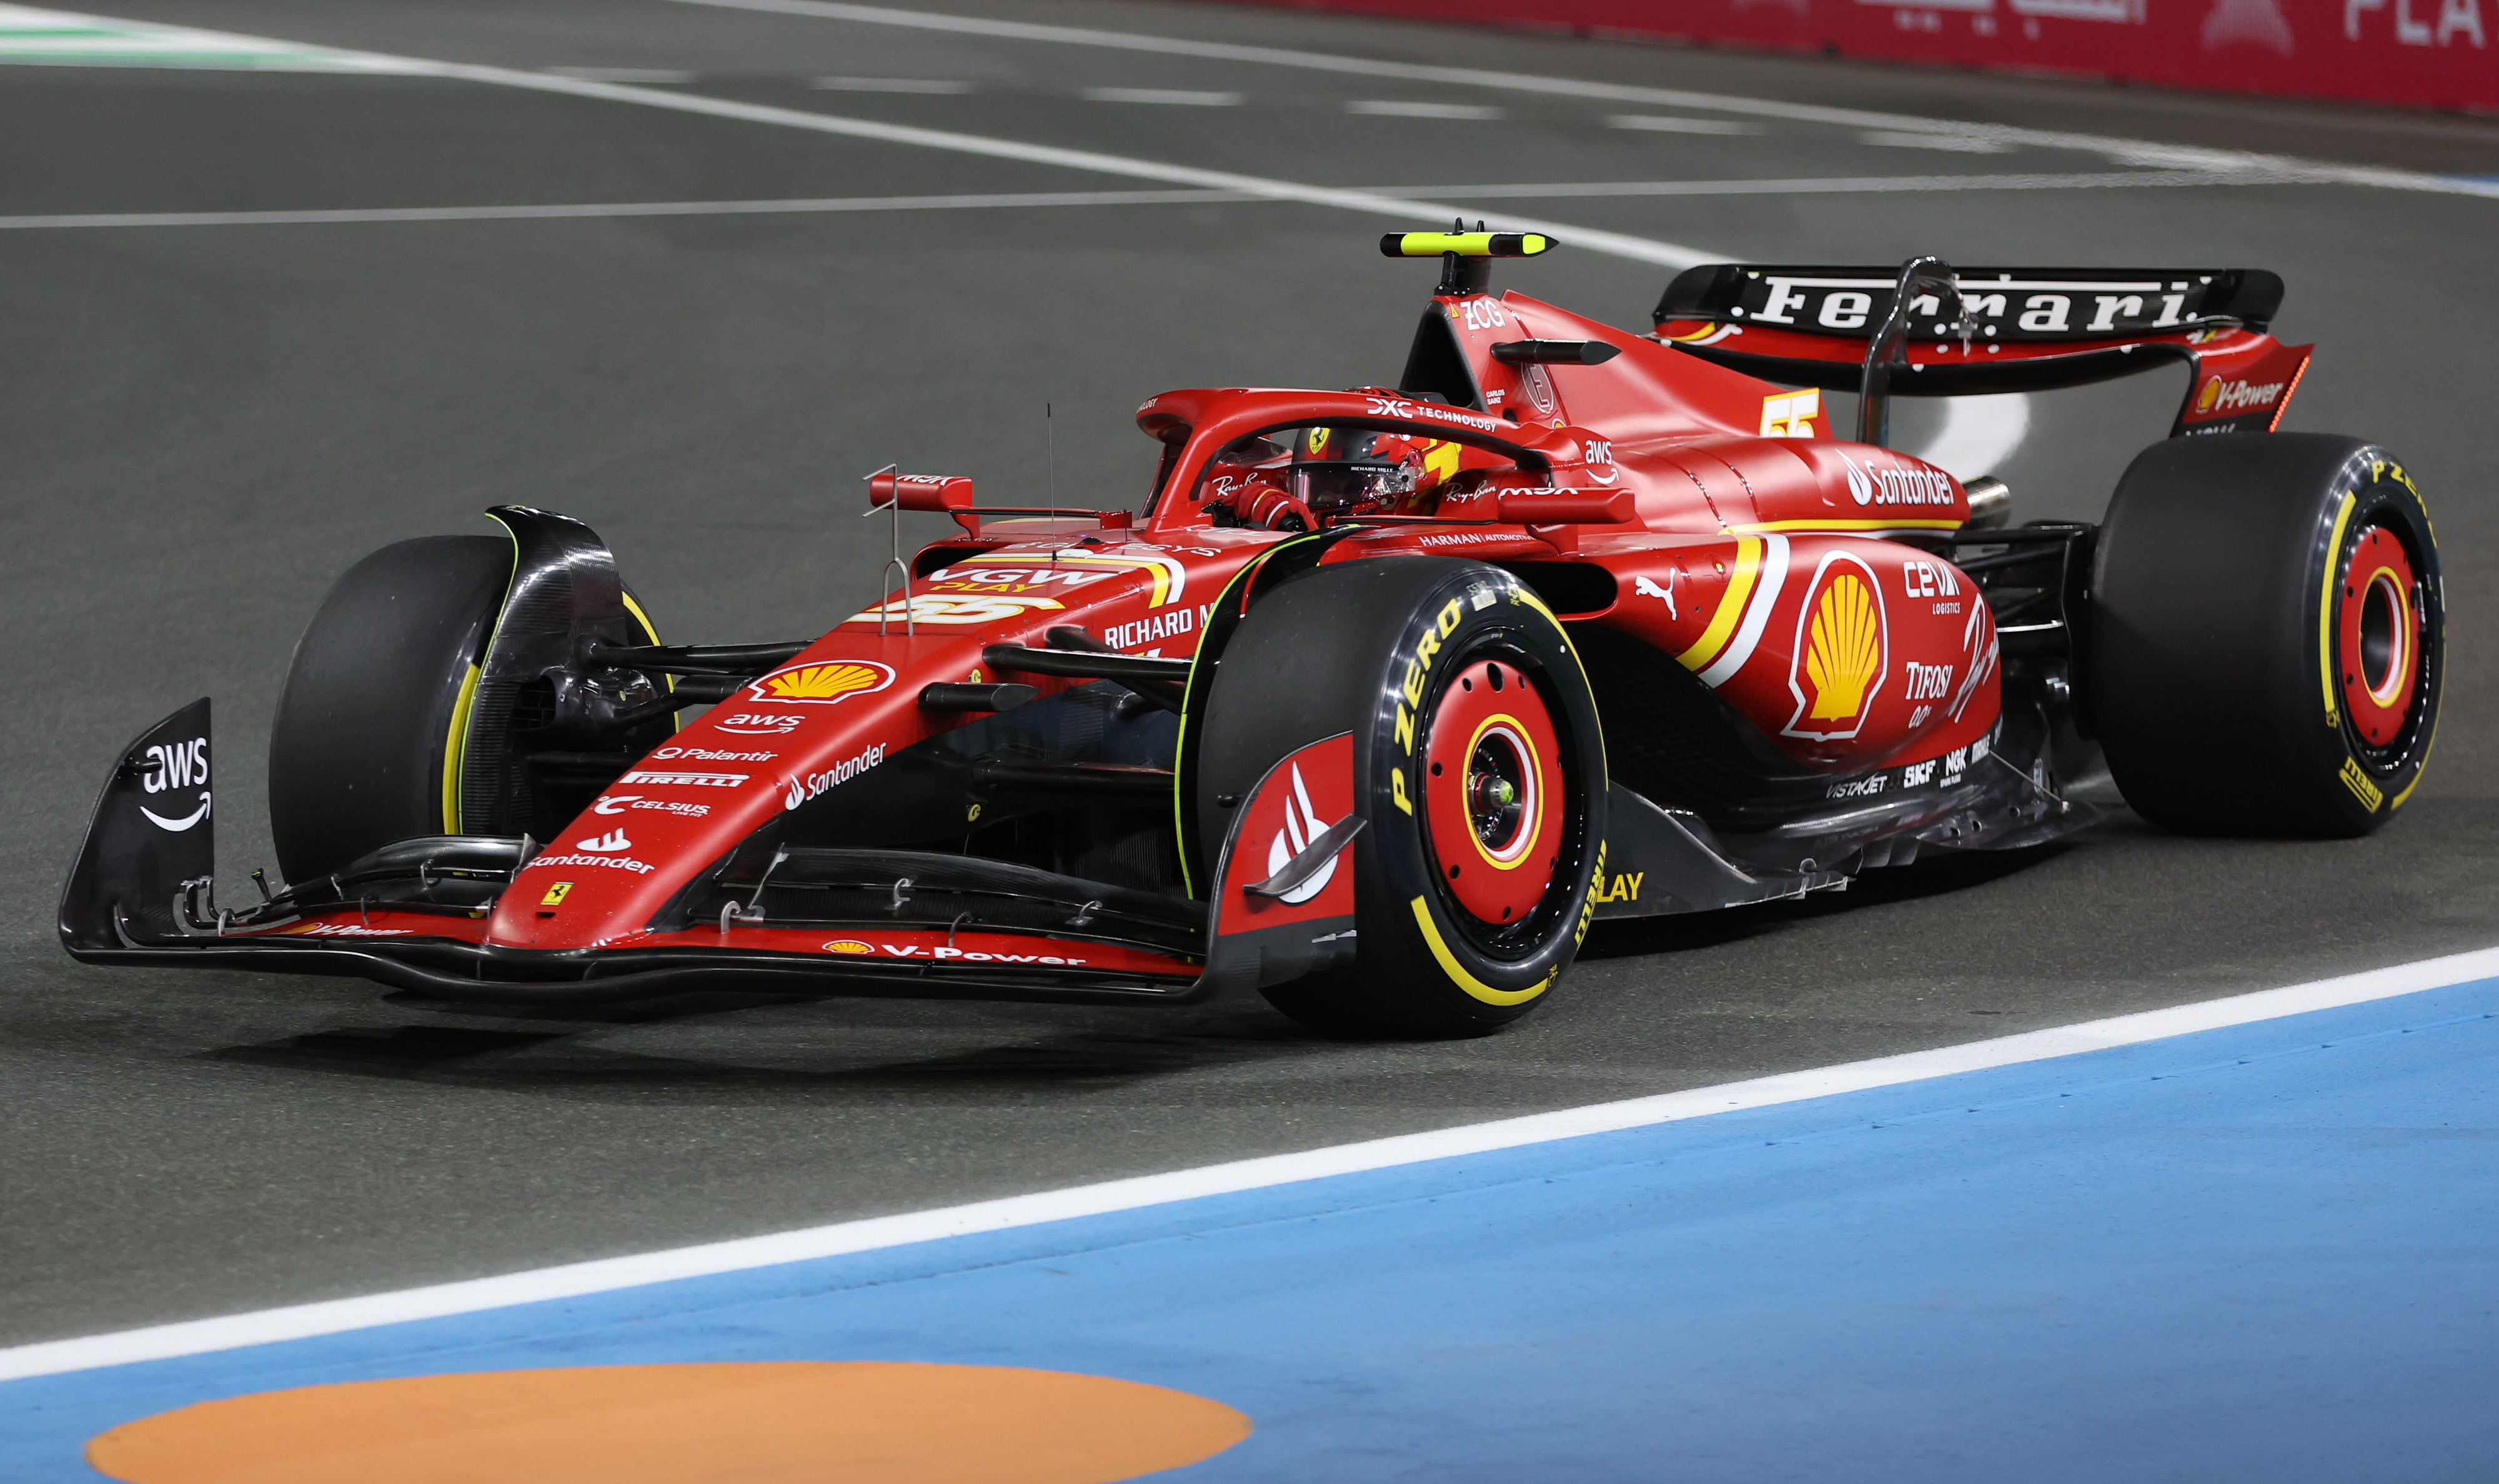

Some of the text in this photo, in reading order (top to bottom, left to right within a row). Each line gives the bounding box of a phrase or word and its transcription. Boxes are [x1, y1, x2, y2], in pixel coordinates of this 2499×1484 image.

[2343, 0, 2499, 49] PLA
[1460, 300, 1506, 330] ZCG
[1486, 389, 1505, 398] CARLOS
[1487, 397, 1501, 405] SAINZ
[2215, 380, 2283, 411] V-Power
[1366, 398, 1496, 432] DXC TECHNOLOGY
[1760, 387, 1820, 438] 55
[1586, 440, 1612, 465] aws
[1864, 460, 1954, 505] Santander
[2372, 460, 2385, 483] P
[1212, 472, 1267, 497] Ray-Bn
[1445, 480, 1497, 503] Ray-Ban
[1419, 533, 1482, 547] HARMAN
[928, 568, 1122, 585] VGW
[930, 582, 1046, 592] PLAY
[840, 594, 1065, 625] 55
[1932, 602, 1960, 615] LOGISTICS
[1105, 608, 1193, 650] RICHARD
[1905, 661, 1953, 700] TIFOSI
[1392, 598, 1461, 816] P ZERO
[723, 714, 805, 726] aws
[144, 737, 209, 793] aws
[680, 749, 778, 761] Palantir
[1945, 746, 1967, 776] NGK
[619, 771, 750, 788] PIRELLI
[805, 743, 886, 801] Santander
[1904, 759, 1935, 789] SKF
[1826, 773, 1887, 798] VISTAJET
[2338, 756, 2383, 814] PIRELLI
[631, 801, 711, 814] CELSIUS
[522, 854, 655, 874] Santander
[1596, 872, 1644, 903] LAY
[303, 925, 414, 935] V-Power
[881, 945, 1086, 966] V-Power
